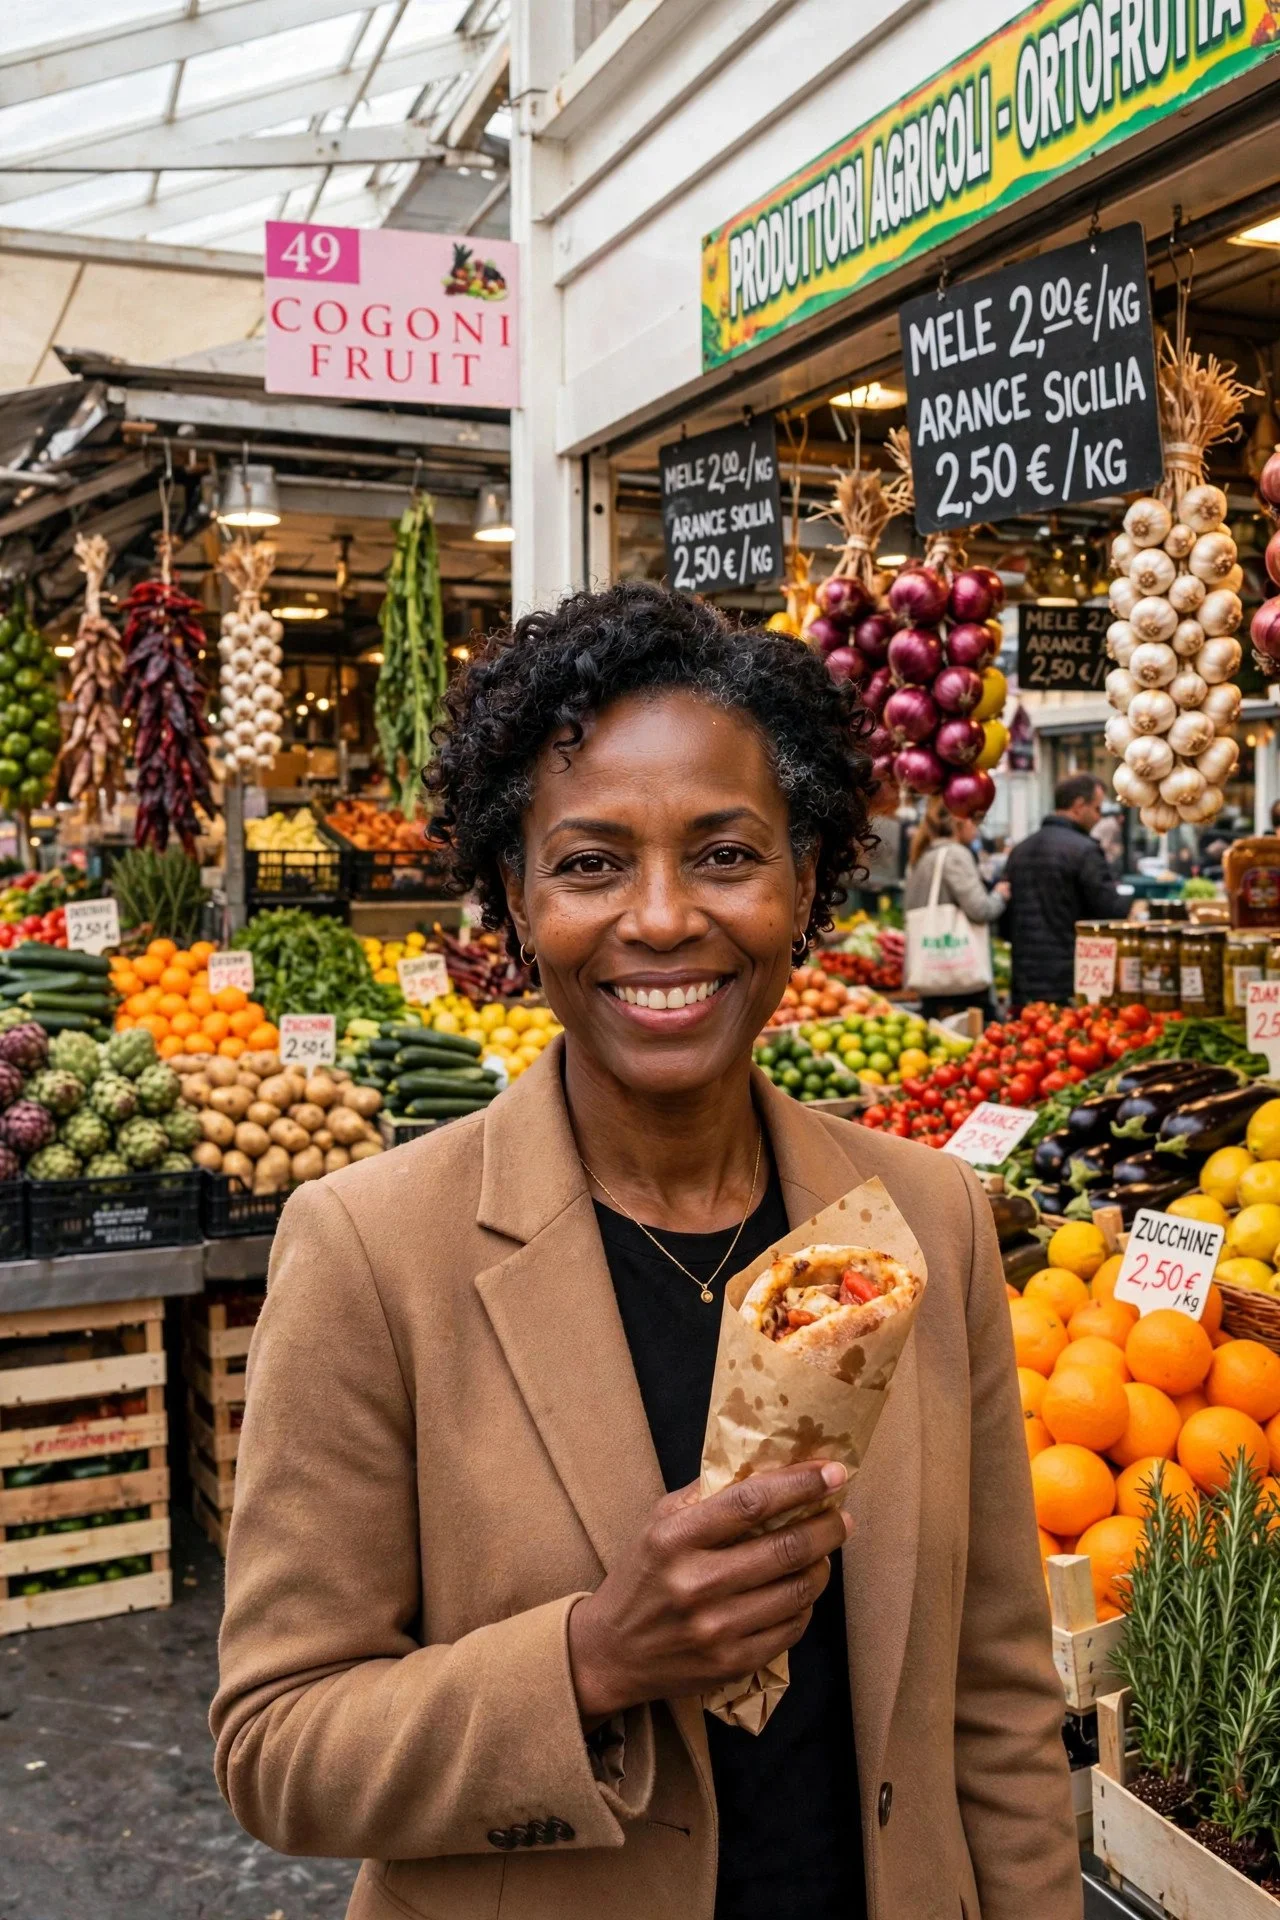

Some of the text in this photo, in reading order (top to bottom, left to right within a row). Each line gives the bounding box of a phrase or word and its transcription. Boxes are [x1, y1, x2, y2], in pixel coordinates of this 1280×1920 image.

[729, 157, 864, 318] PRODUTTORI
[869, 74, 990, 239] AGRICOLI
[280, 230, 341, 275] 49
[271, 296, 511, 348] COGONI
[909, 297, 997, 377] MELE
[309, 343, 481, 387] FRUIT
[917, 355, 1147, 447] ARANCE SICILIA
[664, 457, 706, 495] MELE
[671, 498, 775, 545] ARANCE SICILIA
[1025, 609, 1080, 631] MELE
[1025, 632, 1092, 654] ARANCE
[1134, 1216, 1219, 1257] ZUCCHINE
